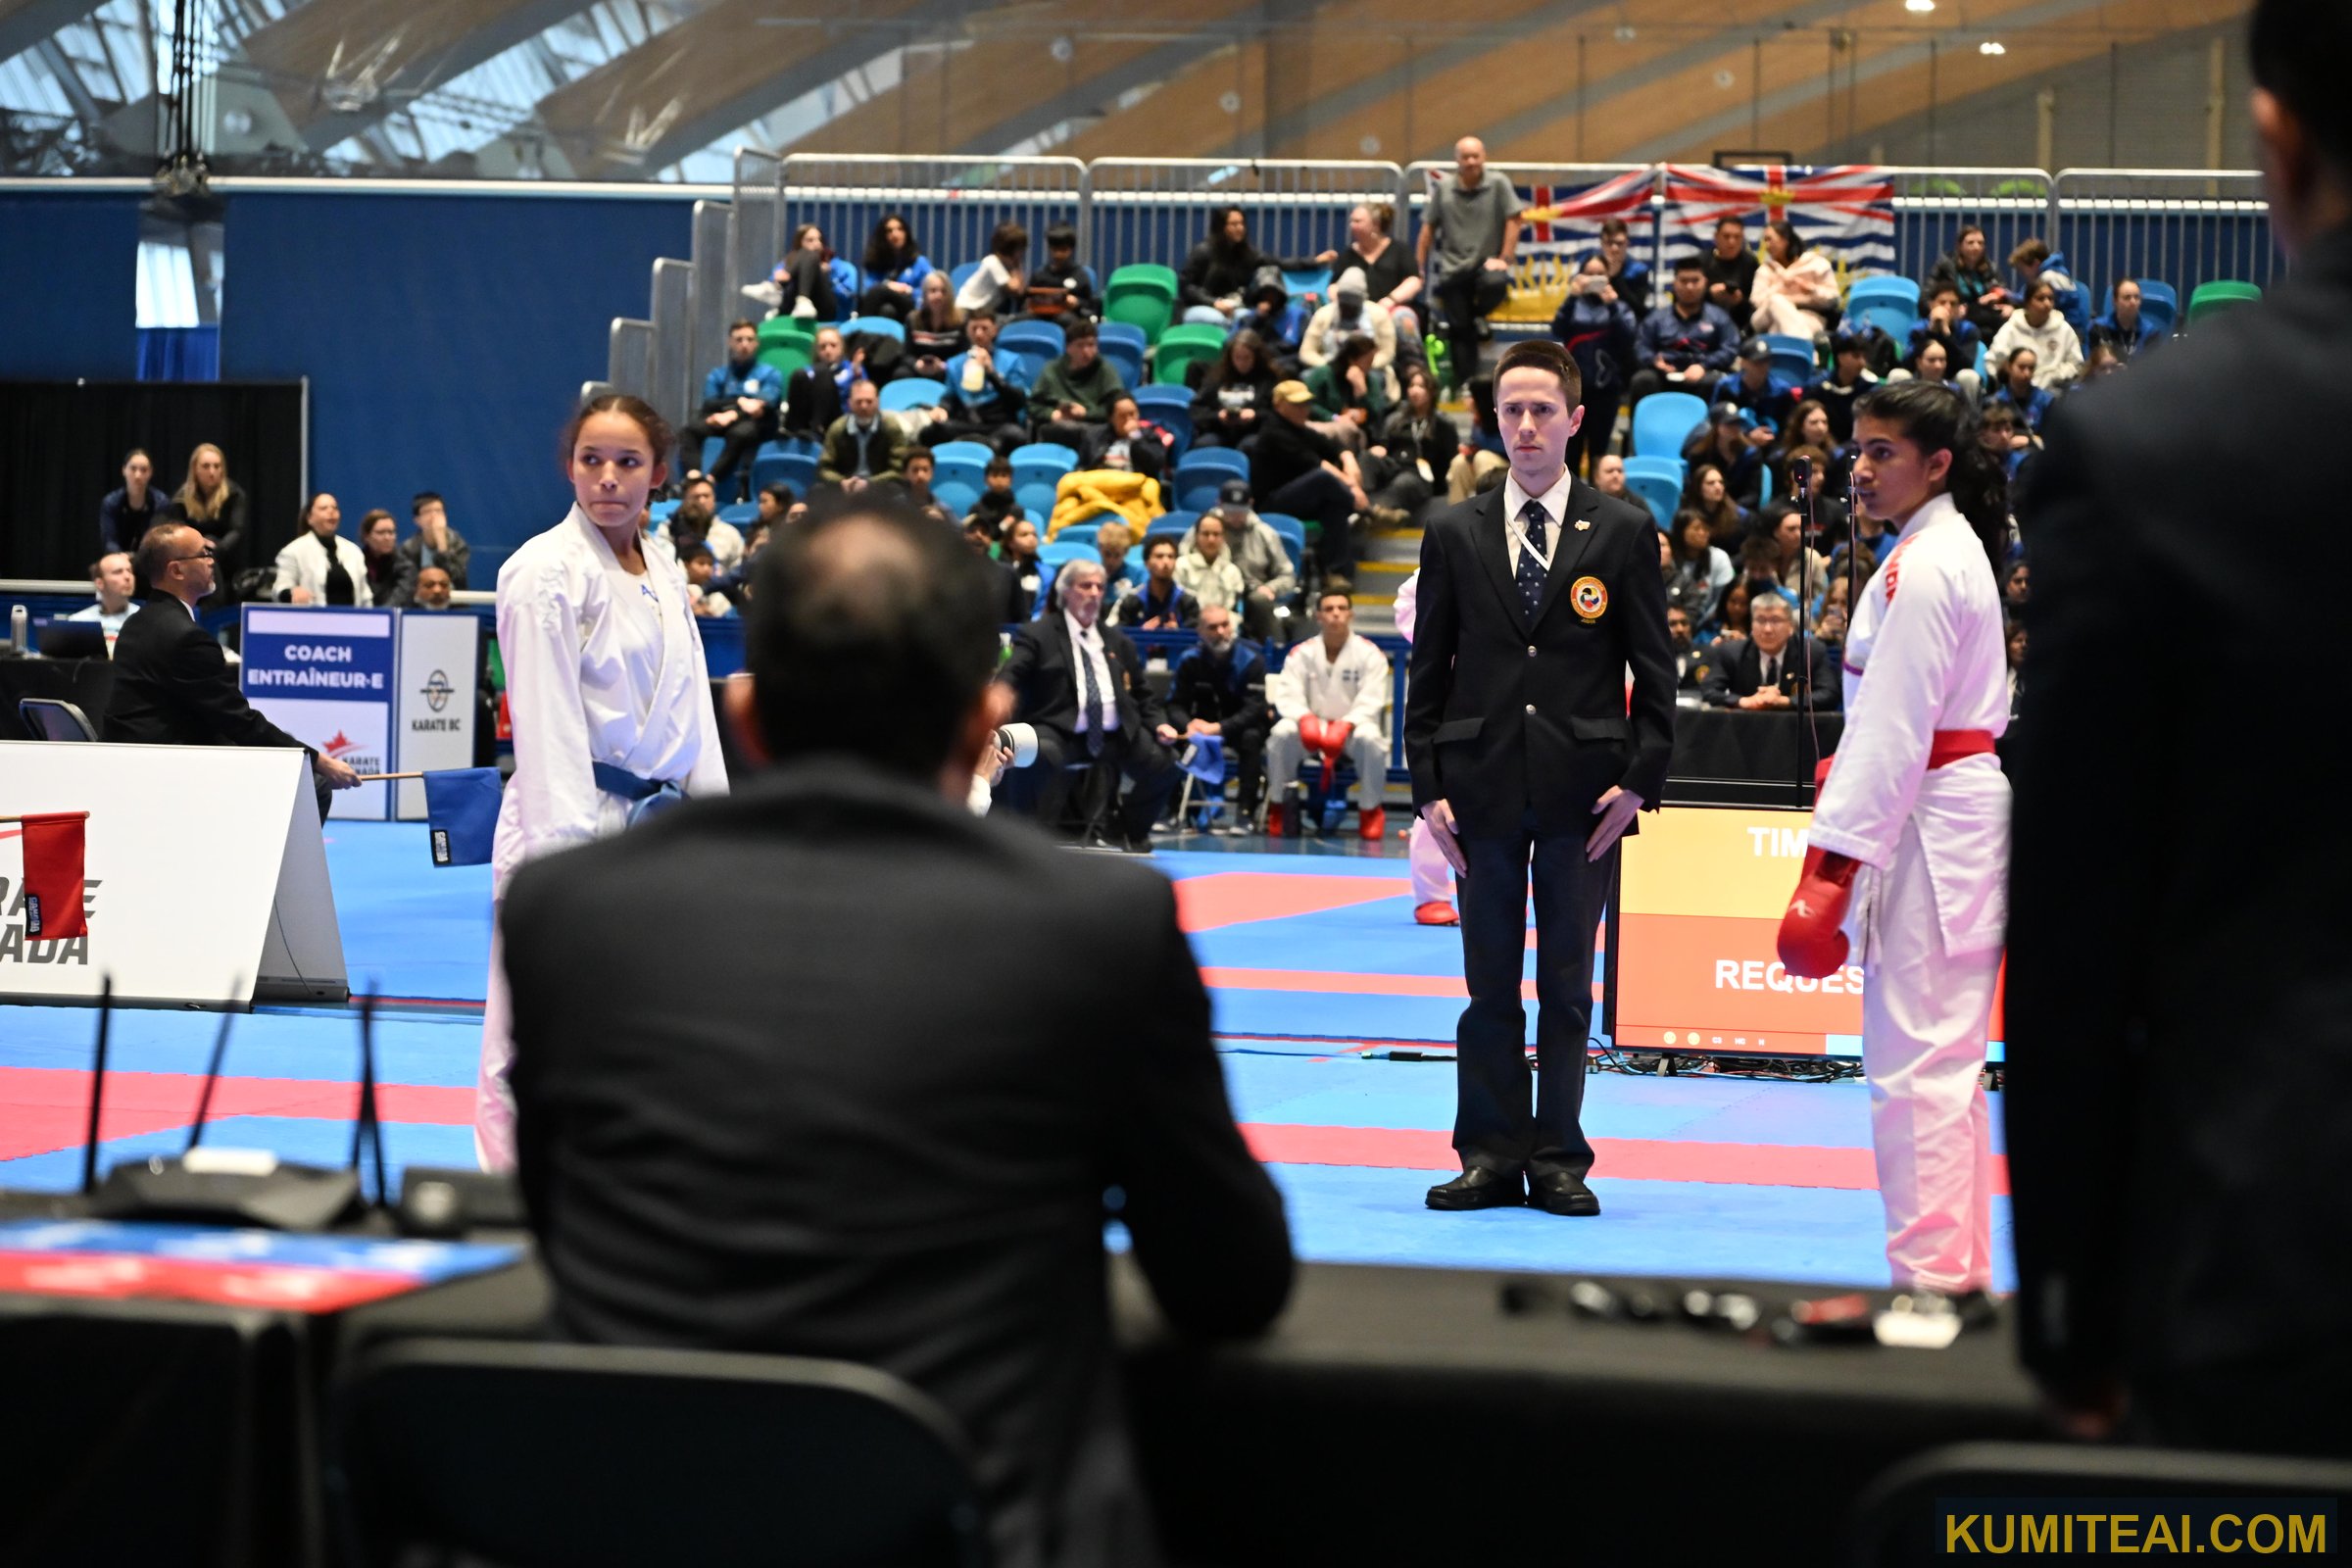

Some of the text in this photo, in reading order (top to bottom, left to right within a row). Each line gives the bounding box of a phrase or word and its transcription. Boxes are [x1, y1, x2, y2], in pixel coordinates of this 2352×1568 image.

[284, 644, 352, 662] COACH
[412, 718, 446, 731] KARATE
[1746, 827, 1809, 858] TIM
[1716, 959, 1865, 994] REQUES
